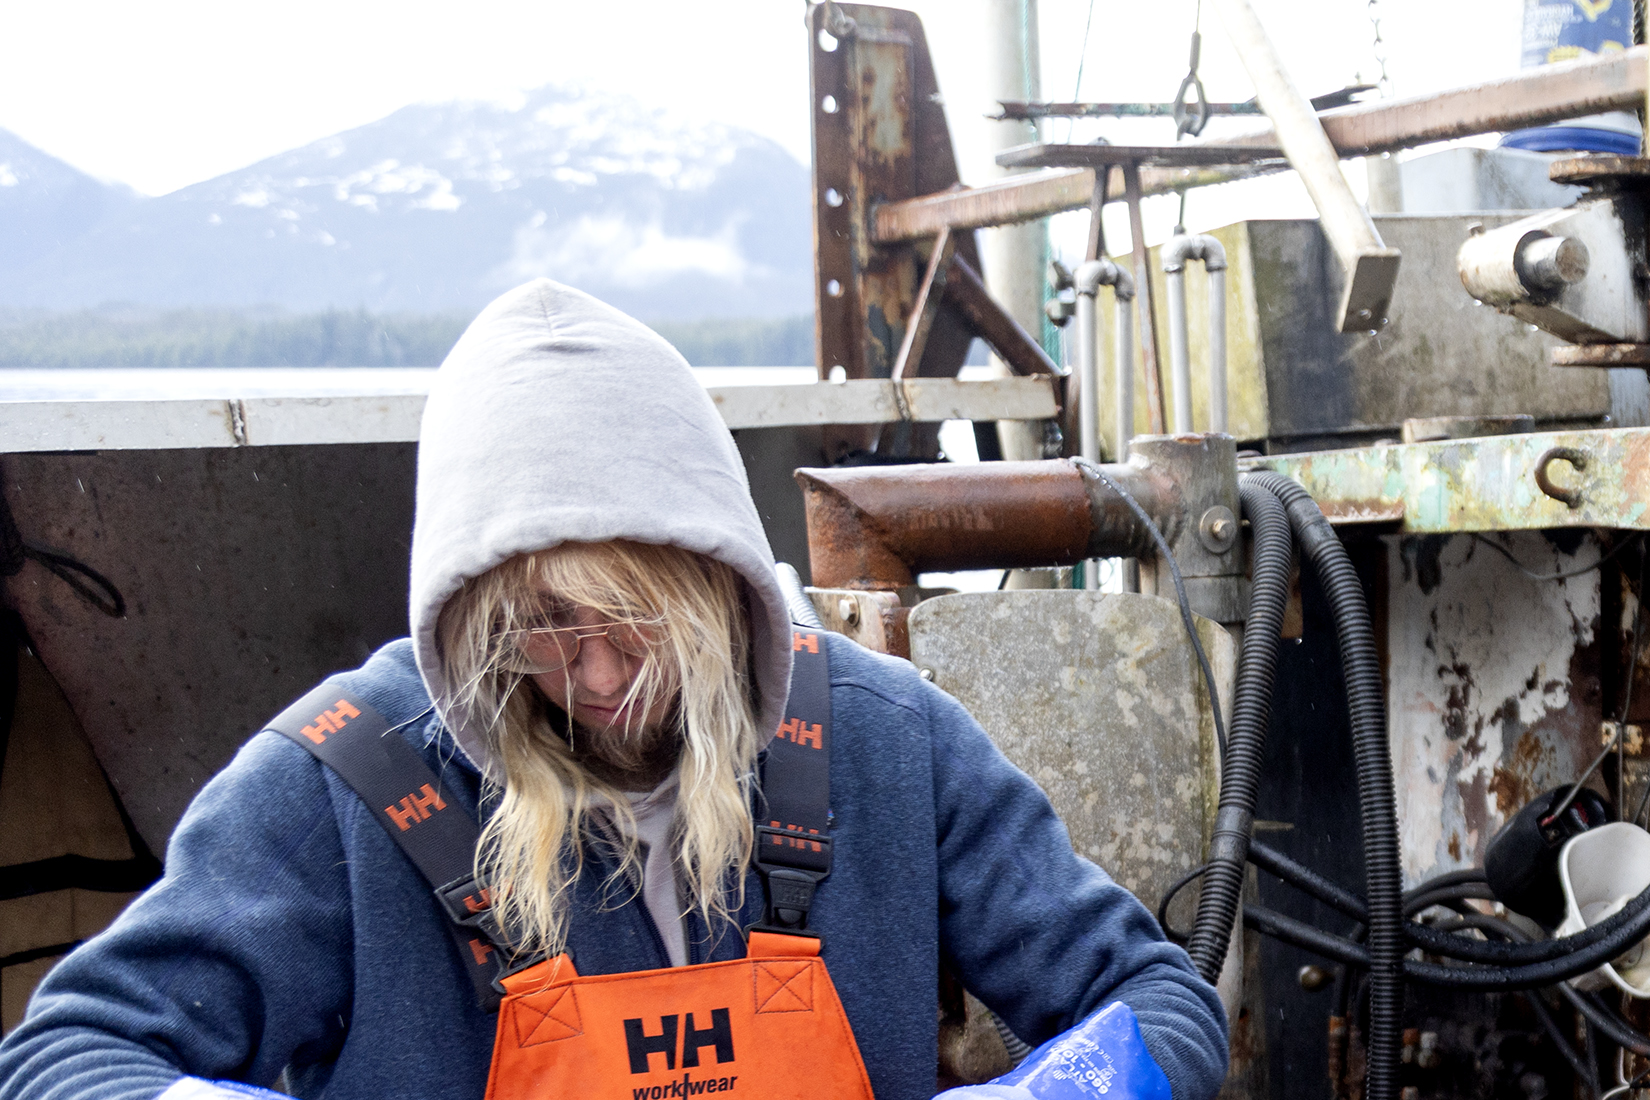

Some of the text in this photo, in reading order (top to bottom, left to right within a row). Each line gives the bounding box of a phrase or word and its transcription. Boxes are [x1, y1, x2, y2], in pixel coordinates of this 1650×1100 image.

[792, 631, 819, 654] H
[301, 699, 361, 745] HH
[776, 717, 823, 750] HH
[384, 783, 447, 832] HH
[623, 1007, 735, 1074] HH
[1084, 1069, 1109, 1095] 660
